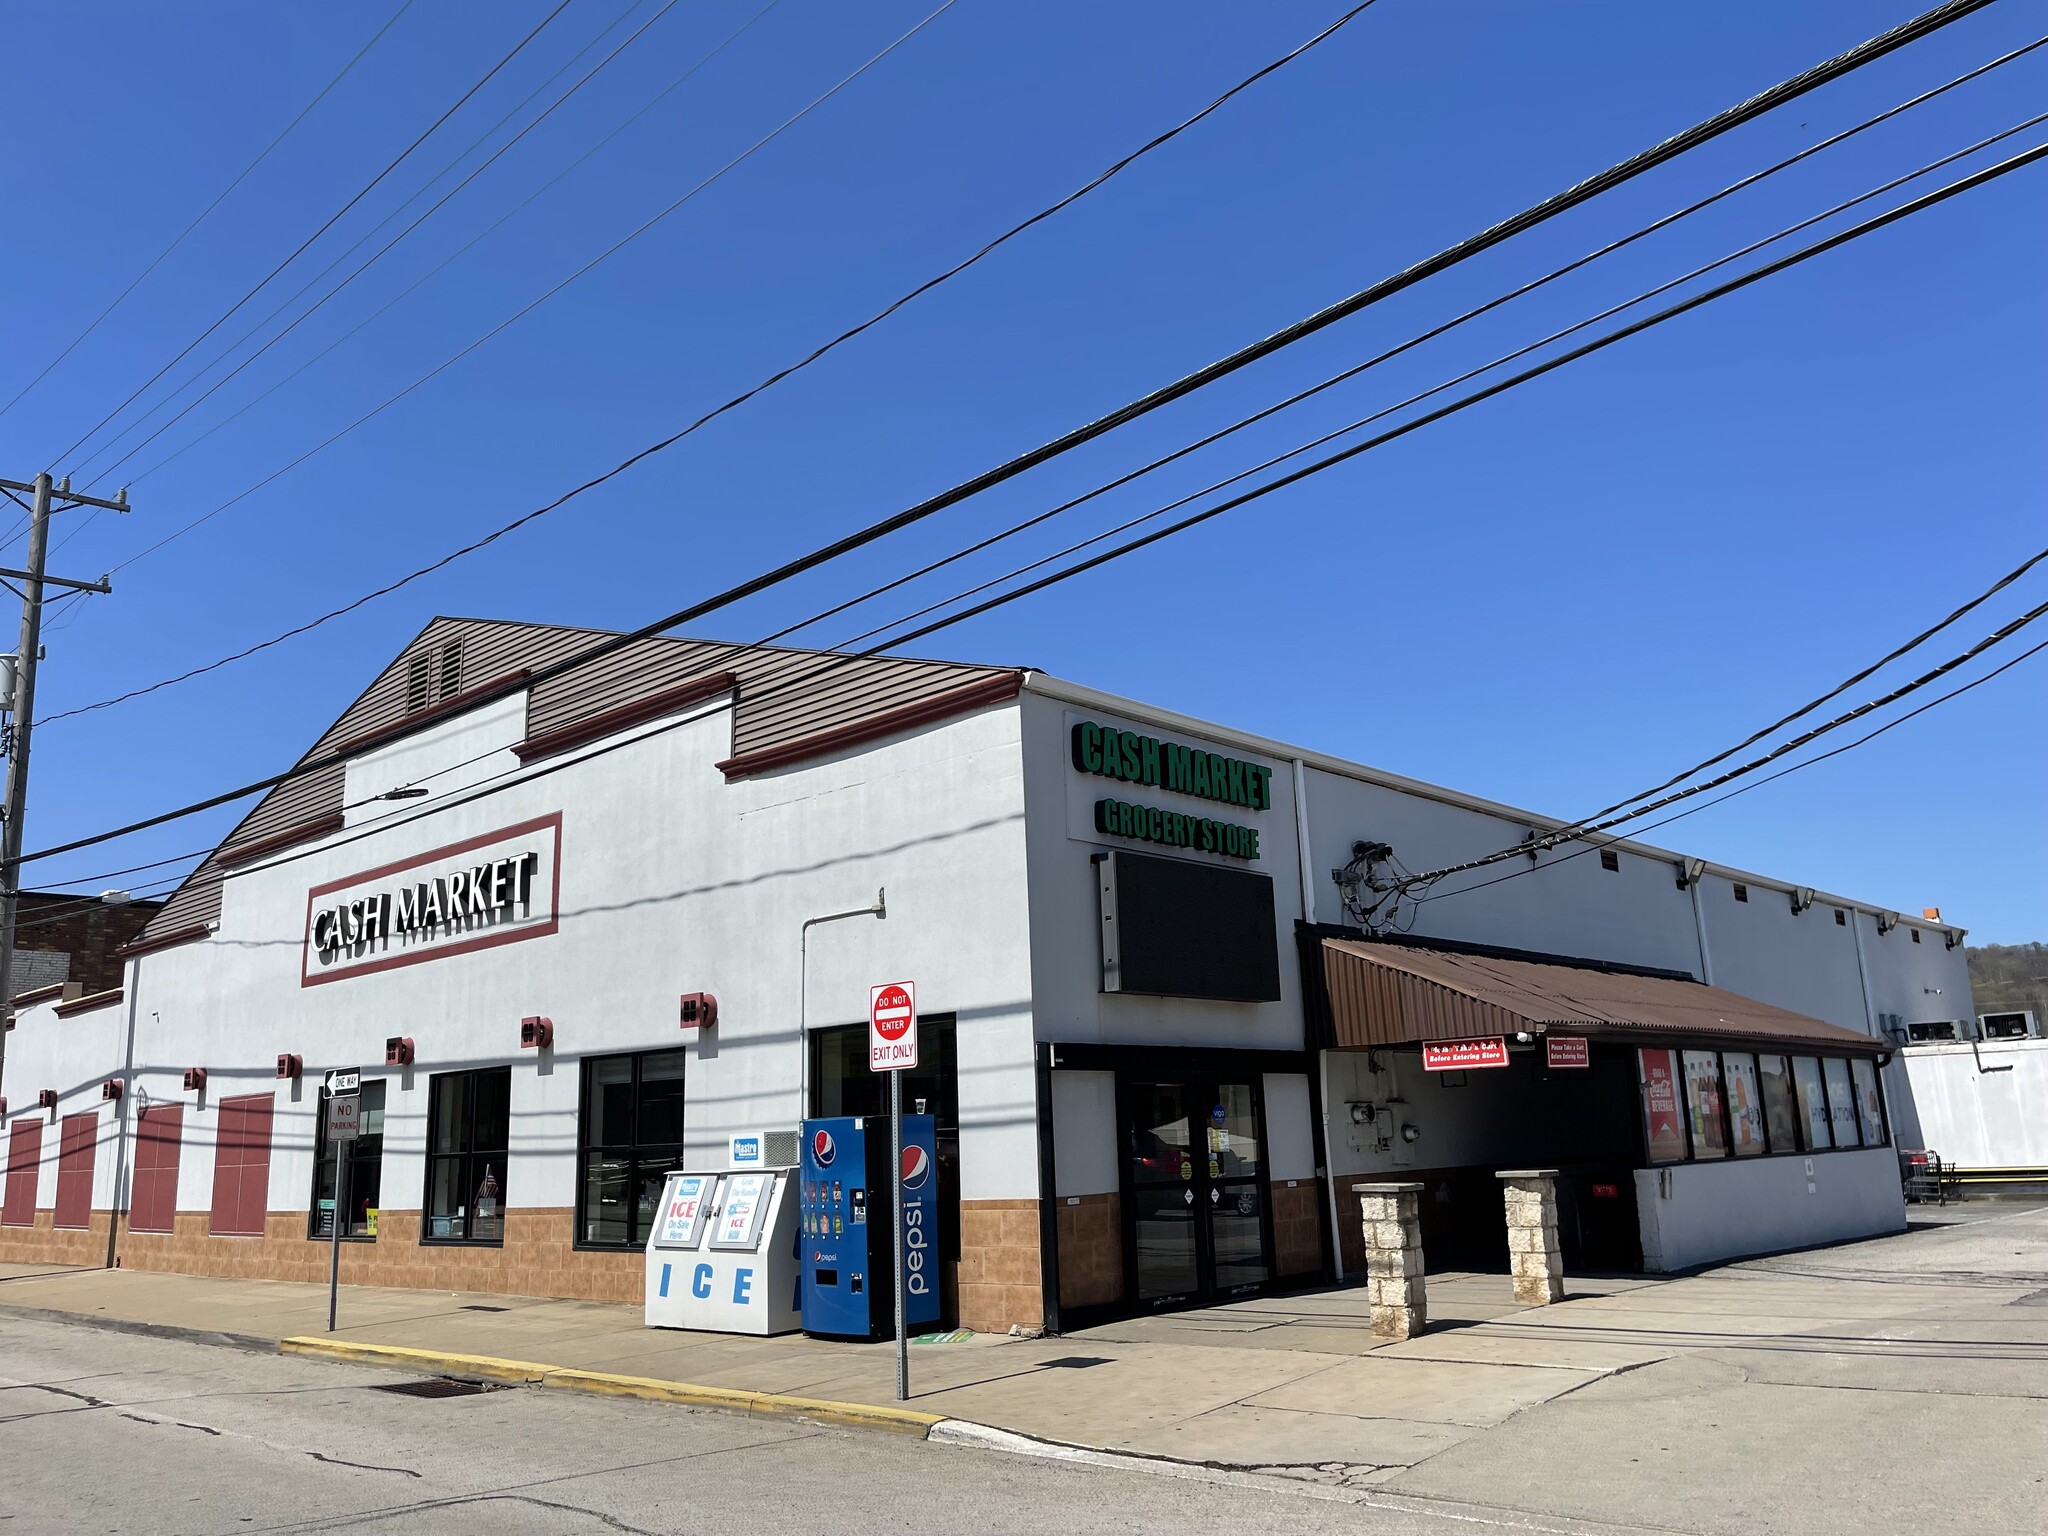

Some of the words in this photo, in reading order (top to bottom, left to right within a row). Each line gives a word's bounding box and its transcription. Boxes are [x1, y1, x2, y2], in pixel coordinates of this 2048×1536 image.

[1075, 721, 1161, 785] CASH
[1164, 743, 1272, 810] MARKET
[1100, 799, 1197, 847] GROCERY
[1201, 818, 1260, 859] STORE
[311, 893, 390, 953] CASH
[395, 852, 535, 933] MARKET
[879, 998, 889, 1006] DO
[893, 995, 906, 1005] NOT
[882, 1020, 904, 1031] ENTER
[873, 1046, 891, 1060] EXIT
[893, 1044, 913, 1059] ONLY
[1453, 1053, 1480, 1061] Entering
[335, 1077, 345, 1088] ONE
[347, 1075, 357, 1086] WAY
[337, 1105, 352, 1116] NO
[330, 1121, 357, 1130] PARKING
[669, 1201, 697, 1218] ICE
[668, 1220, 676, 1228] On
[677, 1219, 690, 1229] Sale
[731, 1219, 744, 1228] ICE
[669, 1231, 683, 1239] Here
[904, 1202, 930, 1296] pepsi
[821, 1253, 837, 1262] pepsi
[659, 1263, 753, 1305] ICE
